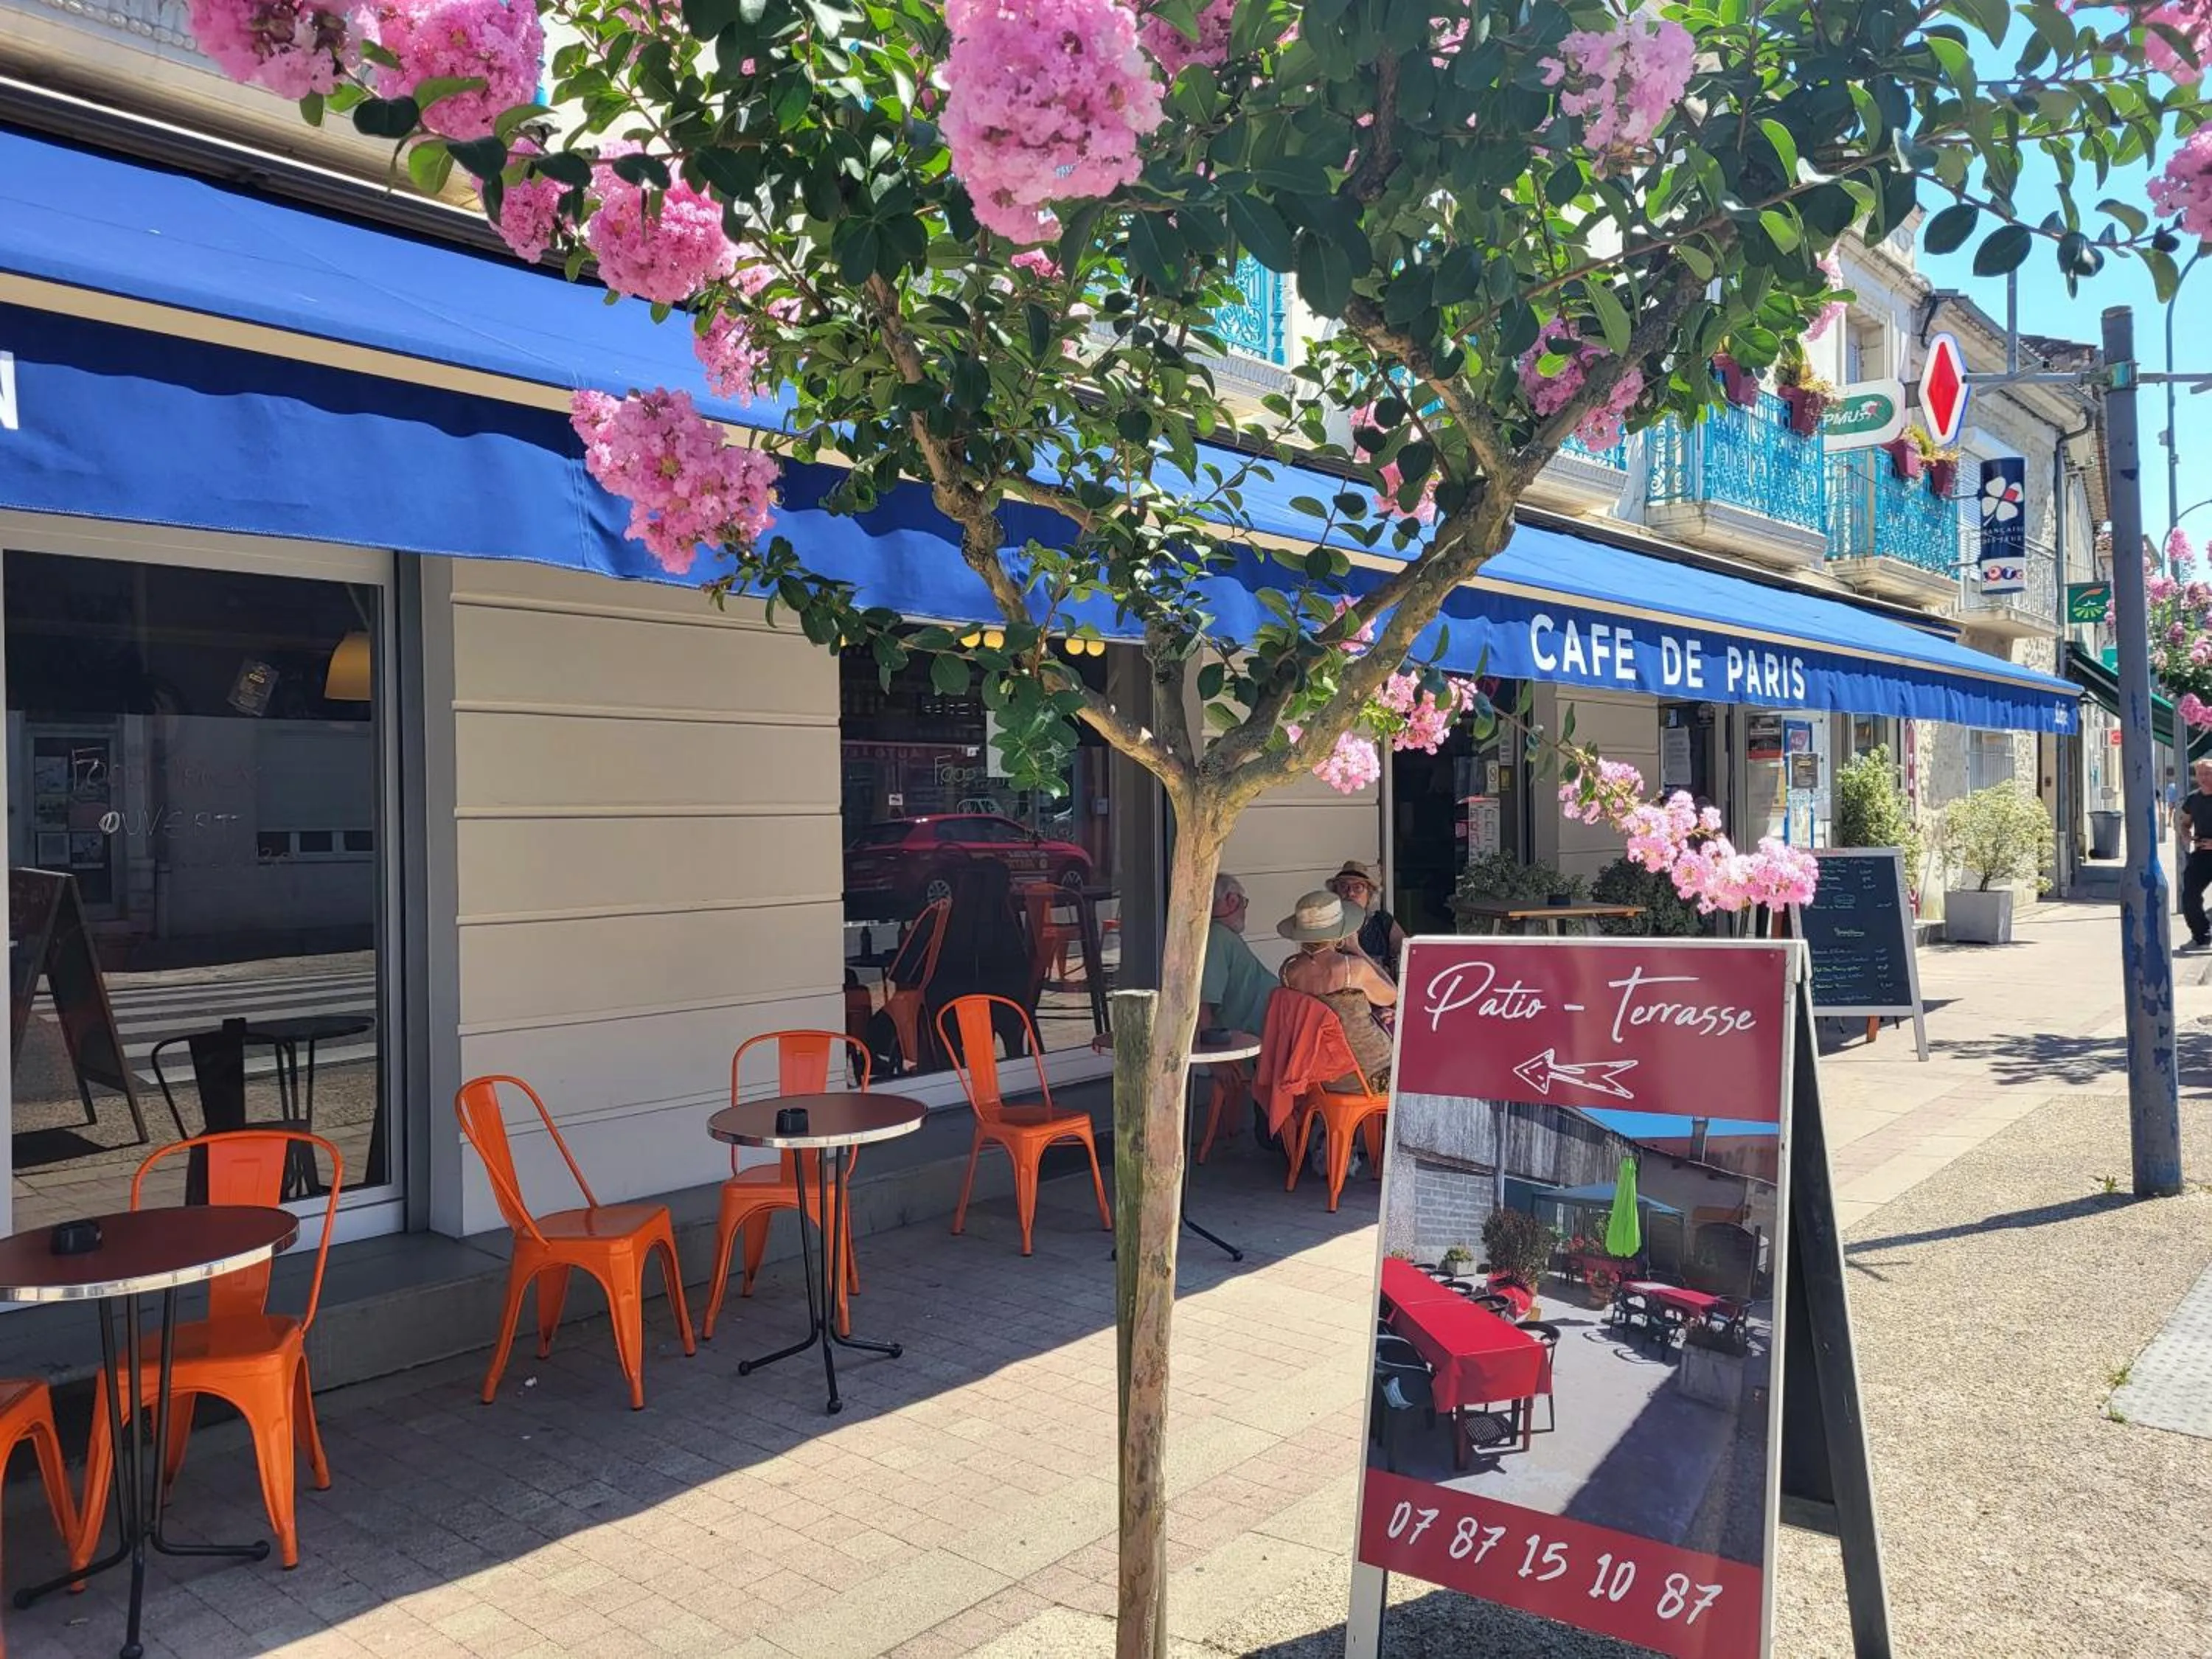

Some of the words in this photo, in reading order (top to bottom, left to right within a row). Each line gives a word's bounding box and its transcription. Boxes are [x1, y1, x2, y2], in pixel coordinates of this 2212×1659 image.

[1530, 613, 1636, 681] CAFE
[1661, 636, 1704, 689] DE
[1727, 647, 1806, 700] PARIS
[1425, 961, 1546, 1031] Patio
[1608, 967, 1756, 1043] Terrasse
[1388, 1501, 1440, 1545] 07
[1449, 1517, 1506, 1564] 87
[1517, 1534, 1568, 1581] 15
[1589, 1553, 1635, 1601] 10
[1657, 1573, 1723, 1625] 87
